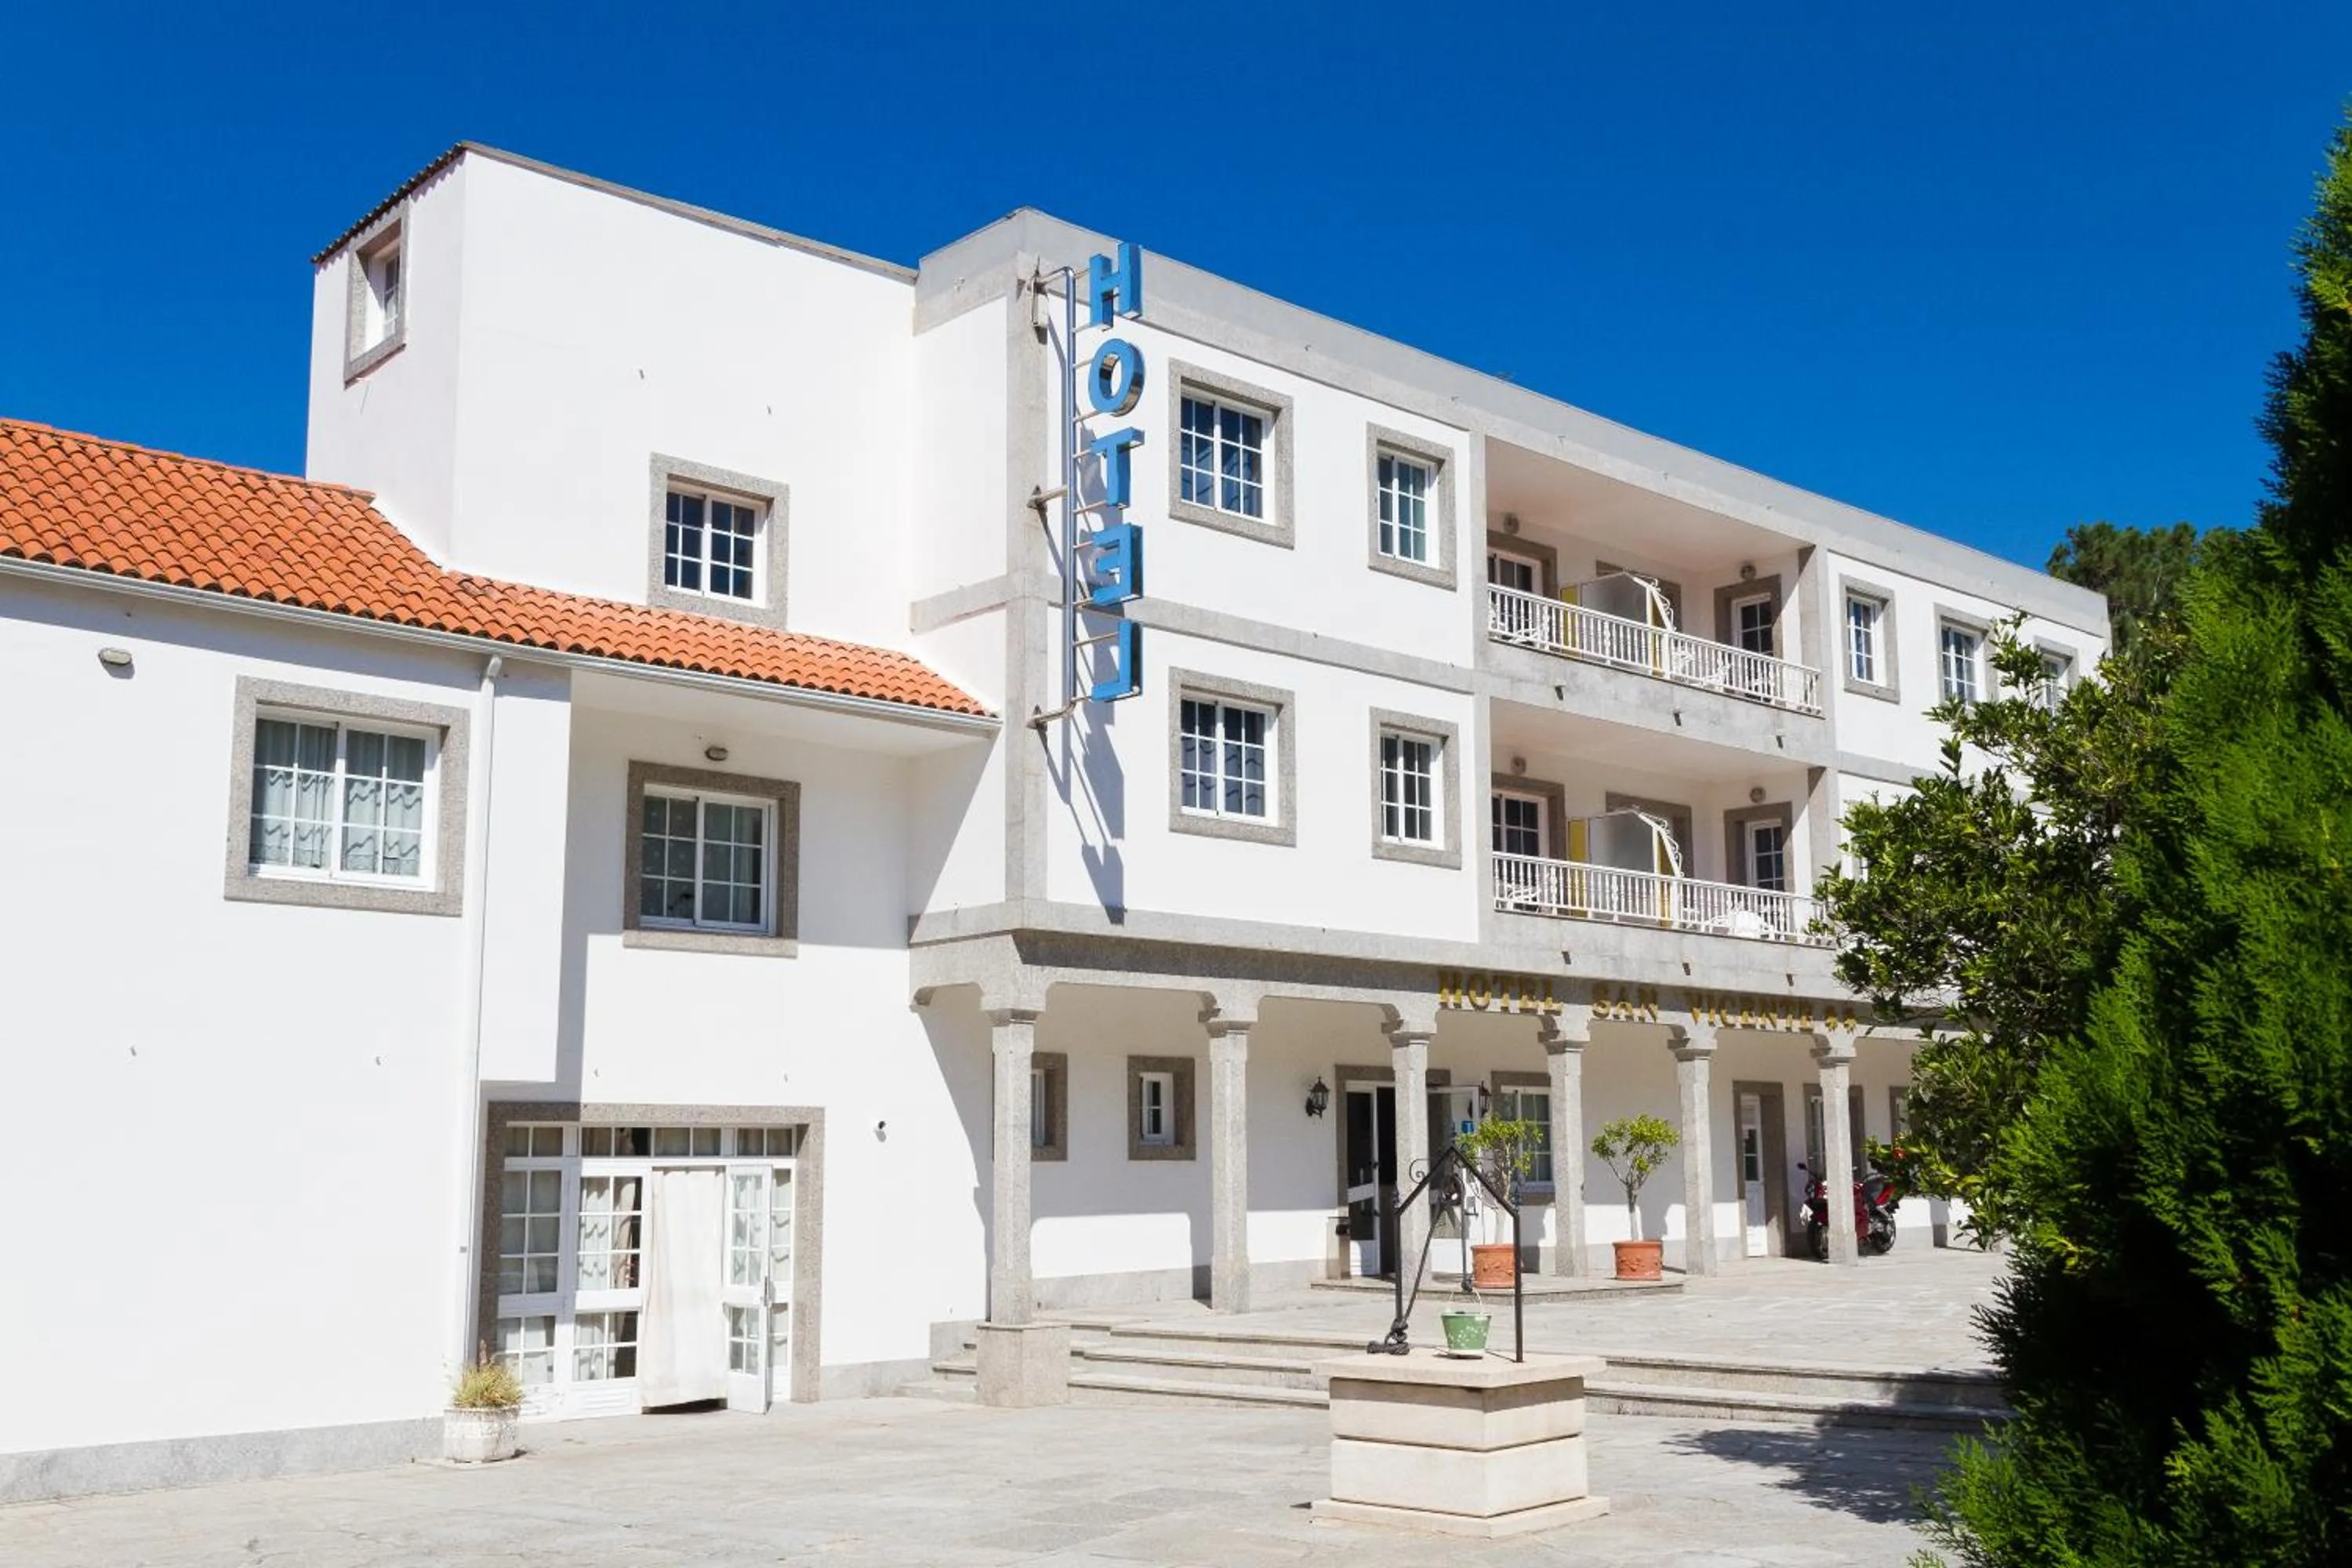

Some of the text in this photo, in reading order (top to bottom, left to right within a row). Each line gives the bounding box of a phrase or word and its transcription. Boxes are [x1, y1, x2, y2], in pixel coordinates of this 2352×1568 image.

[1439, 970, 1813, 1030] HOTEL SAN VICENTE
